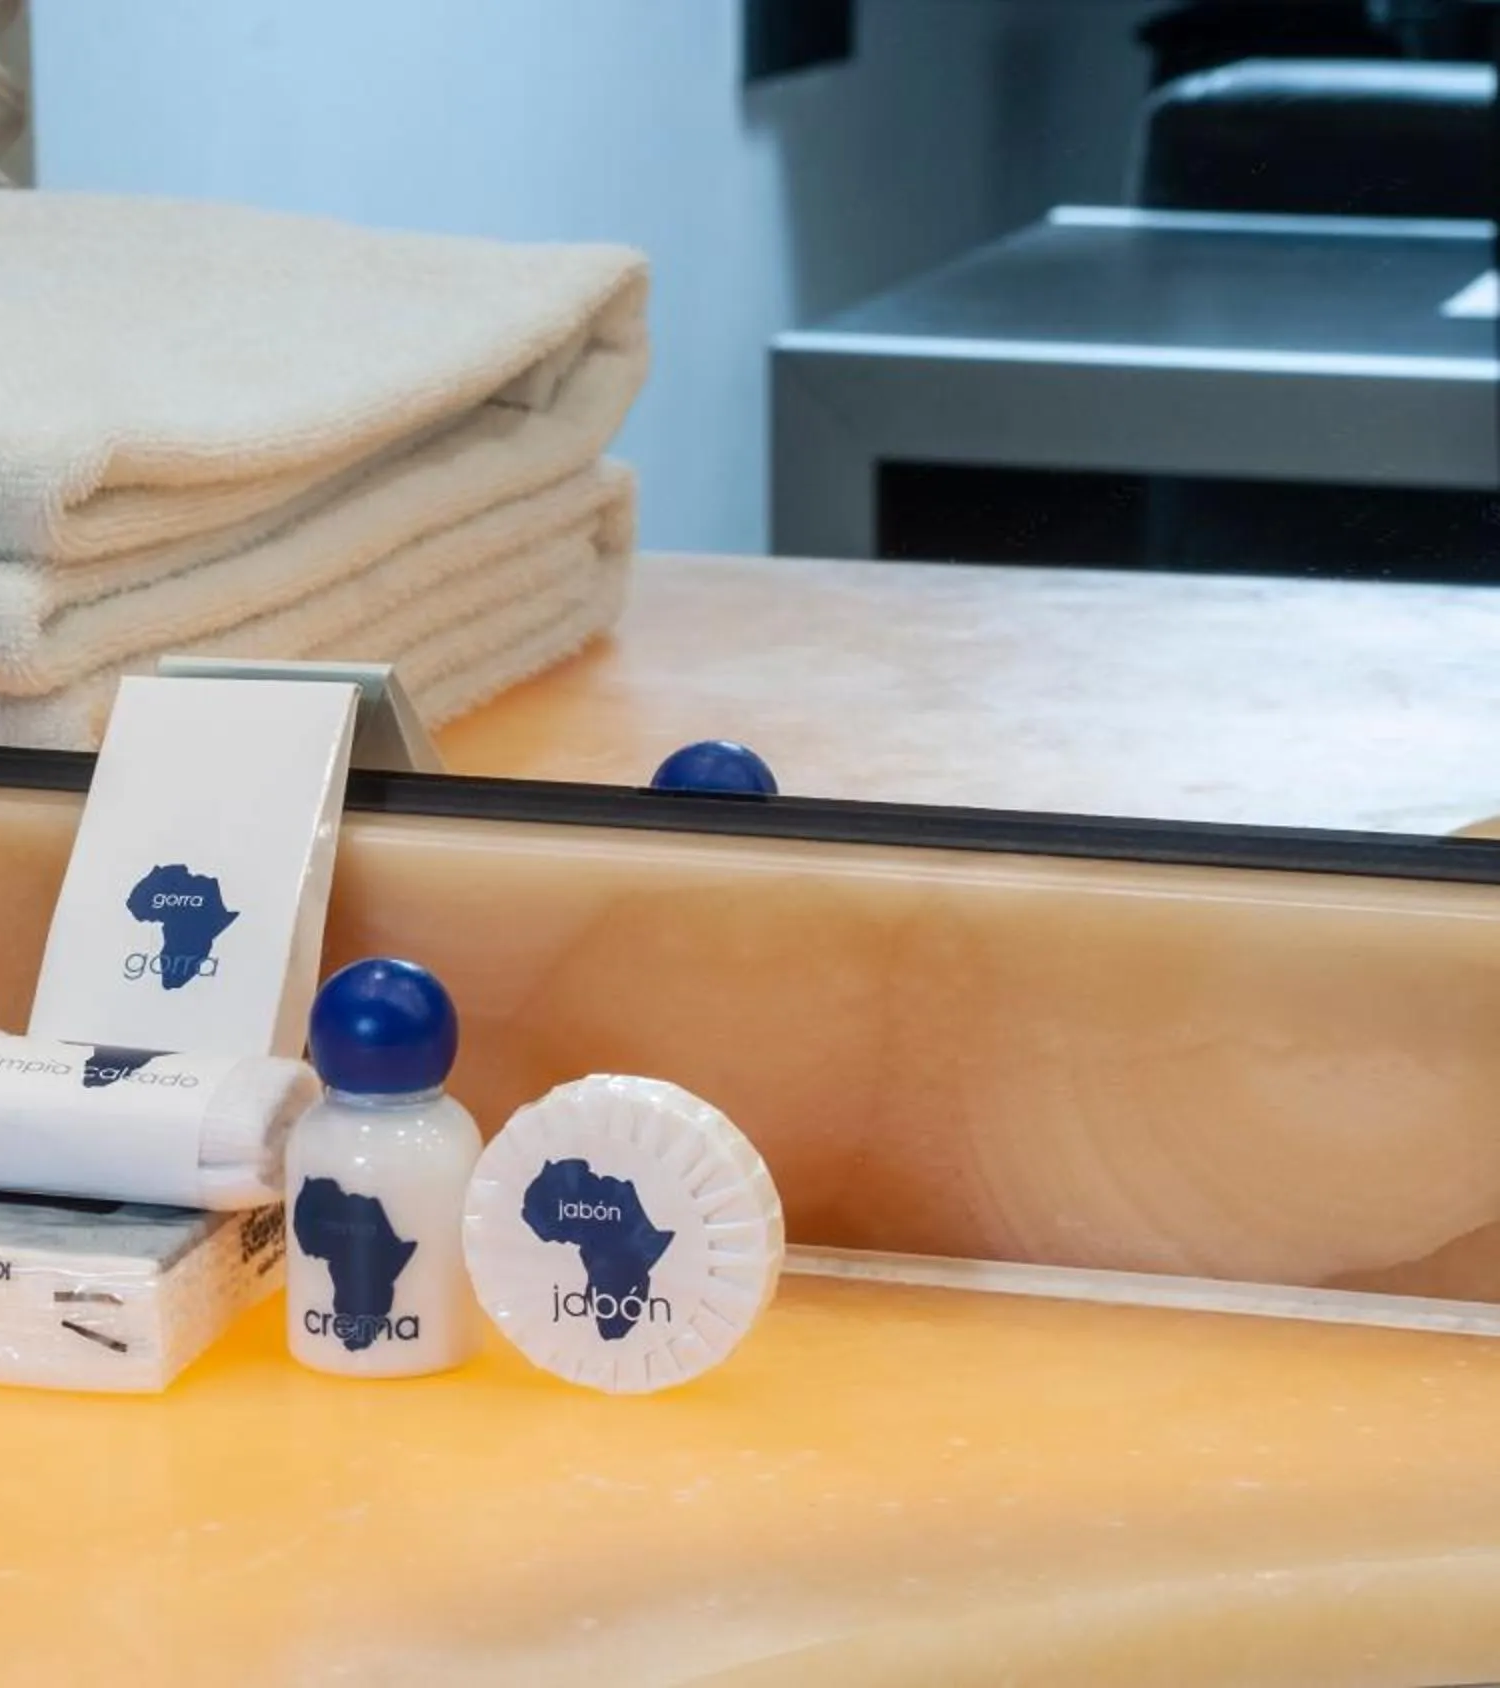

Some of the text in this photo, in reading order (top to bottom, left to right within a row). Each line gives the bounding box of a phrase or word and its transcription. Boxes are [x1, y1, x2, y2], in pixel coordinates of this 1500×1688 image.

[151, 892, 204, 909] gorra
[123, 953, 219, 981] gorra
[558, 1199, 622, 1222] jabón
[552, 1285, 671, 1323] jabón
[304, 1308, 420, 1341] crema
